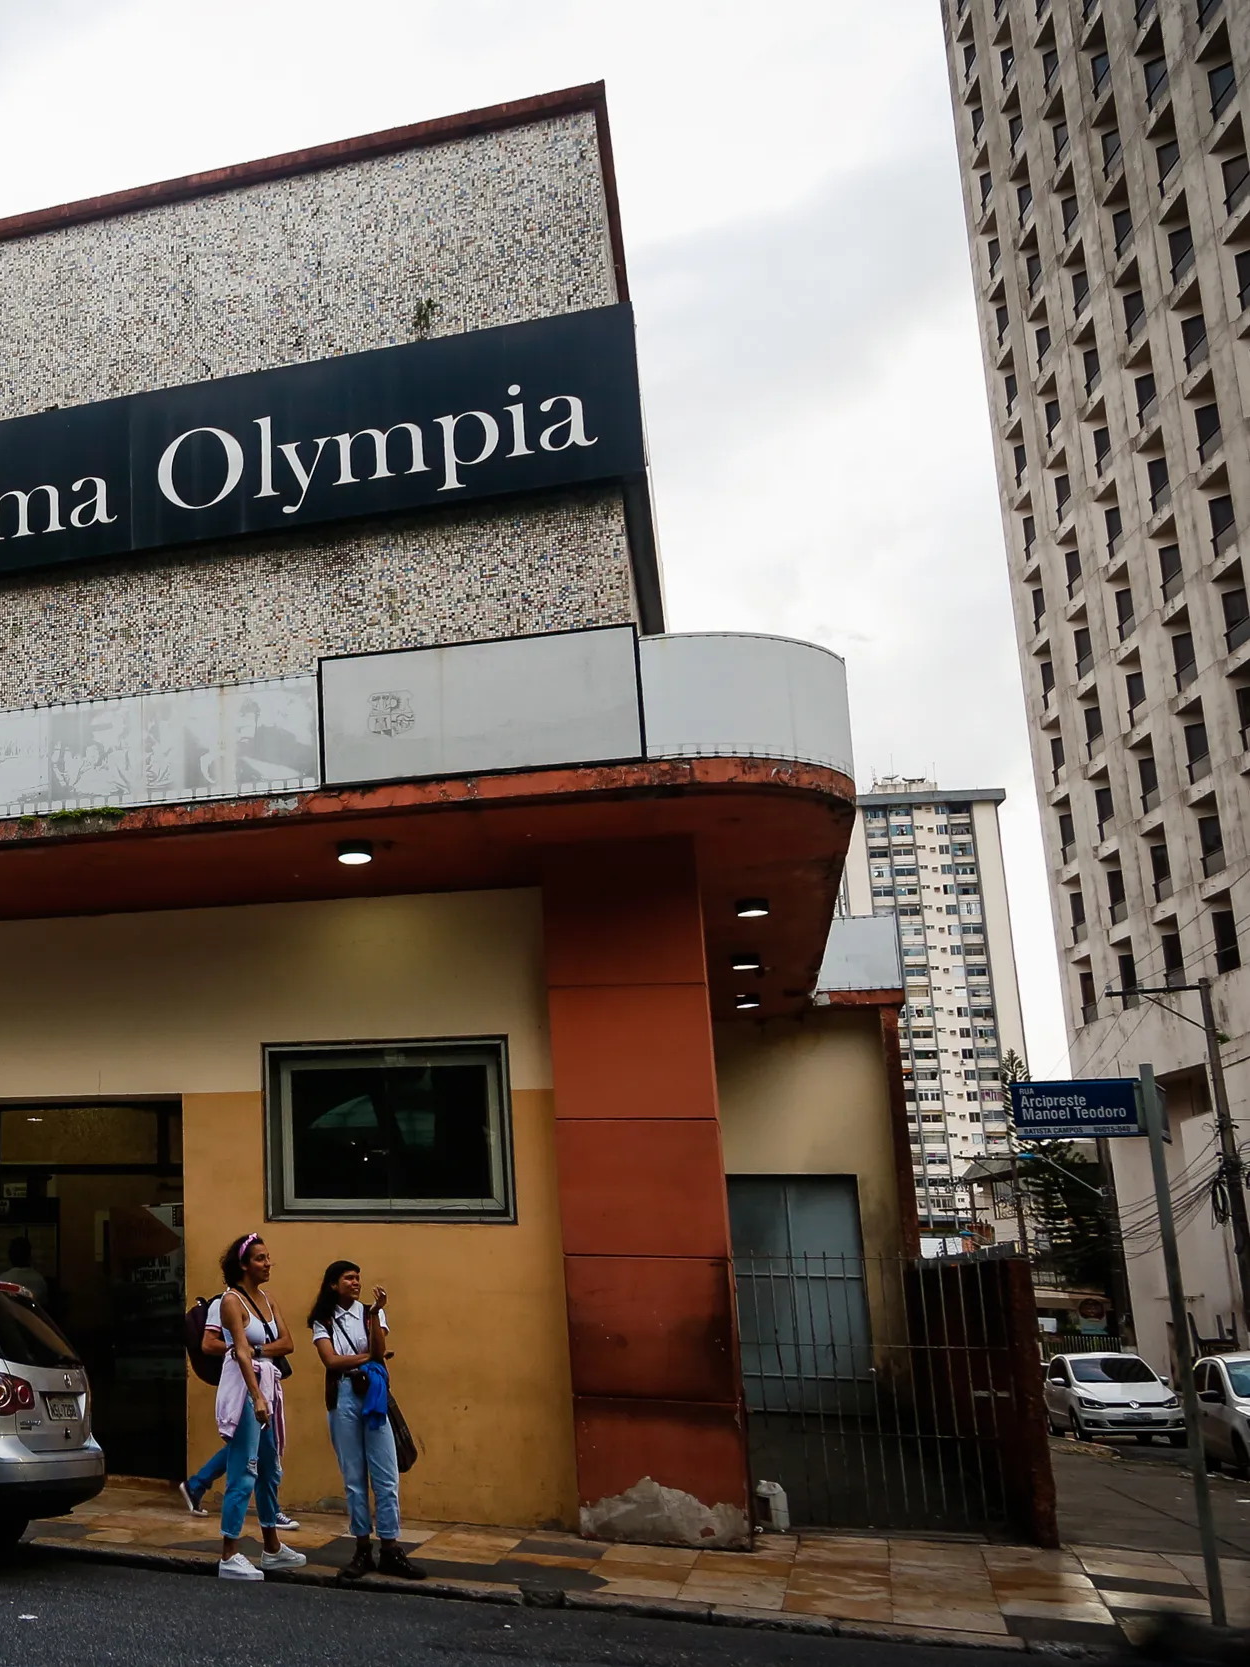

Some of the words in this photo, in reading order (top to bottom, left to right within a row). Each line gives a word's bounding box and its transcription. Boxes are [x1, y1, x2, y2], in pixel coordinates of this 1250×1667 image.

[158, 384, 598, 514] Olympia
[1021, 1095, 1087, 1109] Arcipreste
[1022, 1108, 1071, 1120] Manoel
[1074, 1106, 1127, 1119] Teodoro
[1023, 1127, 1051, 1135] BATISTA
[1053, 1126, 1084, 1134] CAMPOS
